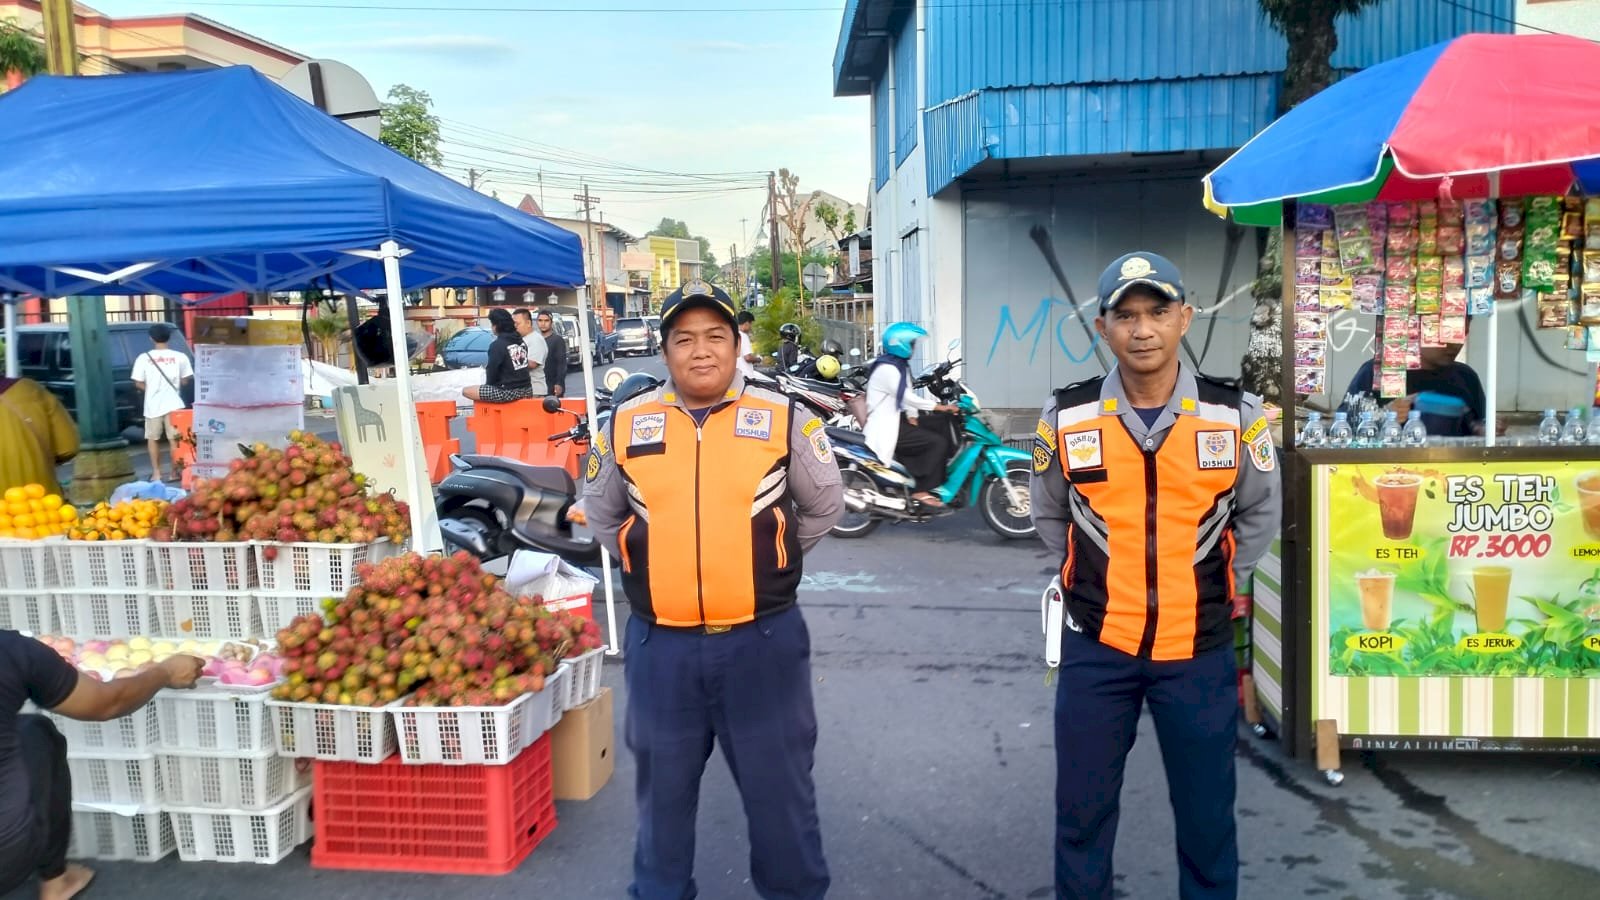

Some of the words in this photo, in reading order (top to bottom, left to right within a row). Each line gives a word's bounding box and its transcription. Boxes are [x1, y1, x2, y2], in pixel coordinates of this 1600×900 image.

[634, 415, 664, 426] DISHUB
[736, 428, 769, 438] DISHUB
[1069, 435, 1097, 447] DISHUB
[1446, 475, 1485, 503] ES
[1493, 473, 1556, 503] TEH
[1447, 502, 1554, 532] JUMBO
[1449, 533, 1552, 558] RP.3000
[1376, 548, 1390, 559] ES
[1394, 548, 1418, 559] TEH
[1359, 636, 1393, 649] KOPI
[1466, 638, 1480, 648] ES
[1483, 638, 1515, 648] JERUK
[1591, 637, 1600, 648] P
